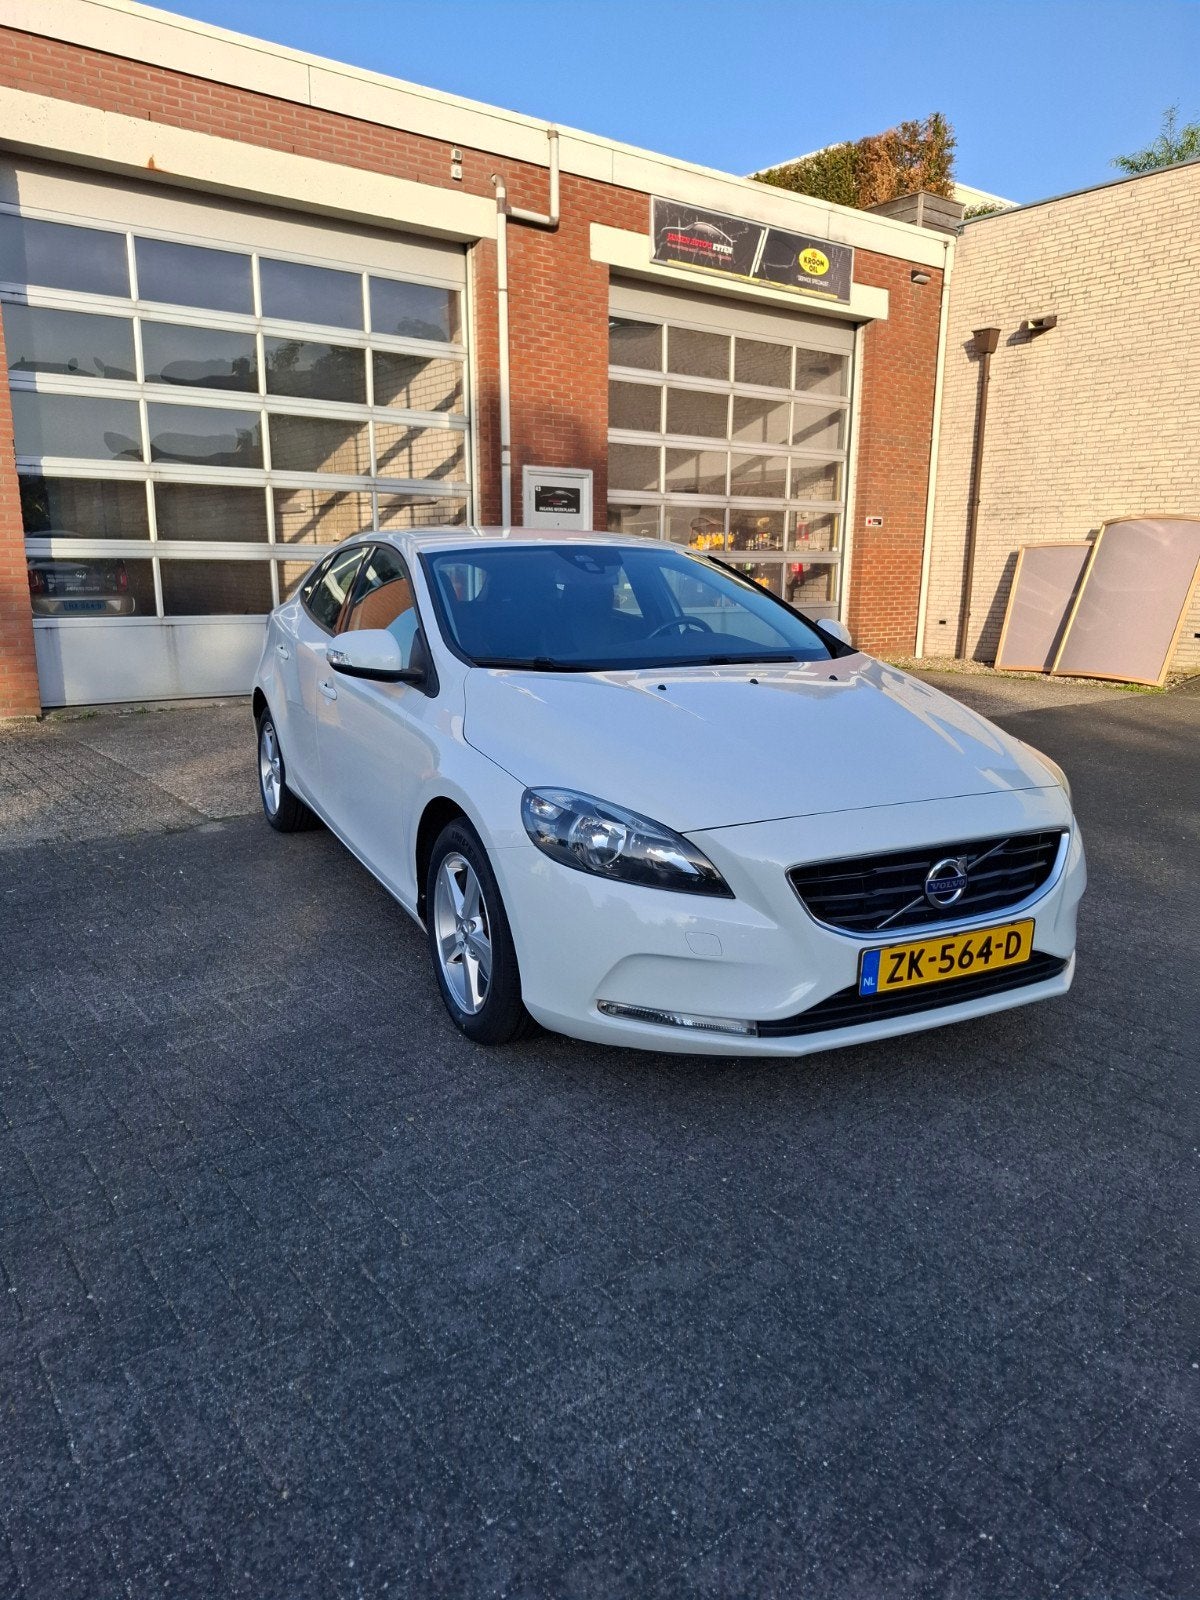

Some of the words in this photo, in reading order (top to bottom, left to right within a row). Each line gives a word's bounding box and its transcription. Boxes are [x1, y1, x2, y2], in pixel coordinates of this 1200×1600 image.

[804, 256, 825, 267] KROON
[809, 265, 819, 273] OIL
[930, 878, 966, 890] VOLVO
[886, 930, 1022, 985] ZK-564-D
[863, 976, 876, 987] NL
